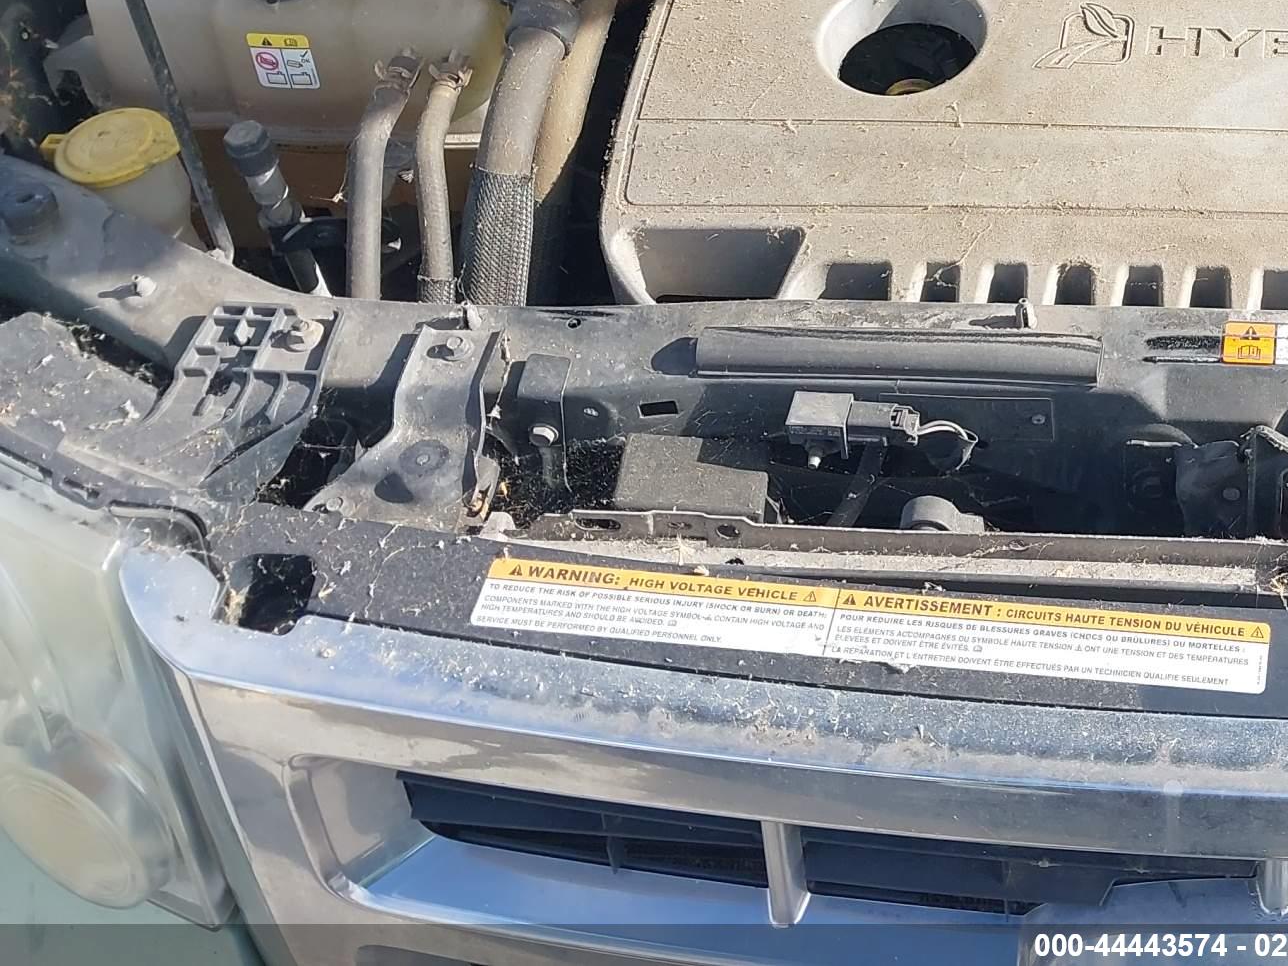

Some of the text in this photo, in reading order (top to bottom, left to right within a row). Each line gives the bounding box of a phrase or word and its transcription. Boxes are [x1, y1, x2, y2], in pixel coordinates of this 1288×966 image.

[502, 583, 535, 593] REDUCE
[543, 587, 554, 595] THE
[556, 589, 576, 597] RISK
[578, 590, 590, 598] OF
[591, 592, 631, 601] POSSIBLE
[634, 595, 670, 605] SERIOUS
[672, 599, 702, 608] INJURY
[783, 608, 794, 616] OR
[527, 565, 797, 601] WARNING: HIGH VOLTAGE VEHICLE
[476, 615, 509, 624] SERVICE
[534, 619, 545, 627] BE
[546, 620, 595, 632] PERFORMED
[596, 625, 607, 633] BY
[609, 626, 650, 637] QUALIFIED
[480, 603, 500, 611] HIGH
[501, 605, 563, 616] TEMPERATURES
[565, 610, 581, 618] AND
[583, 612, 615, 621] SHOULD
[484, 594, 538, 605] COMPONENTS
[540, 599, 572, 609] MARKED
[574, 602, 594, 610] WITH
[596, 604, 610, 612] THE
[612, 605, 631, 613] HIGH
[632, 607, 668, 617] VOLTAGE
[771, 619, 805, 629] VOLTAGE
[807, 622, 824, 630] AND
[863, 594, 992, 616] AVERTISSEMENT
[1005, 608, 1061, 622] CIRCUITS
[1065, 612, 1105, 625] HAUTE
[1109, 616, 1161, 629] TENSION
[1165, 620, 1181, 631] DU
[1185, 620, 1245, 637] VÉHICULE
[836, 625, 852, 633] LES
[971, 636, 1009, 646] SYMBOLE
[1010, 639, 1037, 648] HAUTE
[1038, 641, 1073, 651] TENSION
[1084, 644, 1100, 653] ONT
[1102, 646, 1118, 654] UNE
[1121, 648, 1154, 657] TENSION
[1156, 650, 1166, 658] ET
[1168, 652, 1184, 660] DES
[839, 613, 864, 621] POUR
[906, 618, 922, 626] LES
[925, 620, 963, 630] RISQUES
[965, 623, 977, 631] DE
[979, 624, 1030, 635] BLESSURES
[1033, 628, 1067, 638] GRAVES
[1105, 634, 1118, 642] OU
[1188, 641, 1240, 652] MORTELLES
[871, 636, 881, 644] ET
[882, 637, 916, 647] DOIVENT
[957, 656, 991, 665] DOIVENT
[1081, 666, 1092, 674] UN
